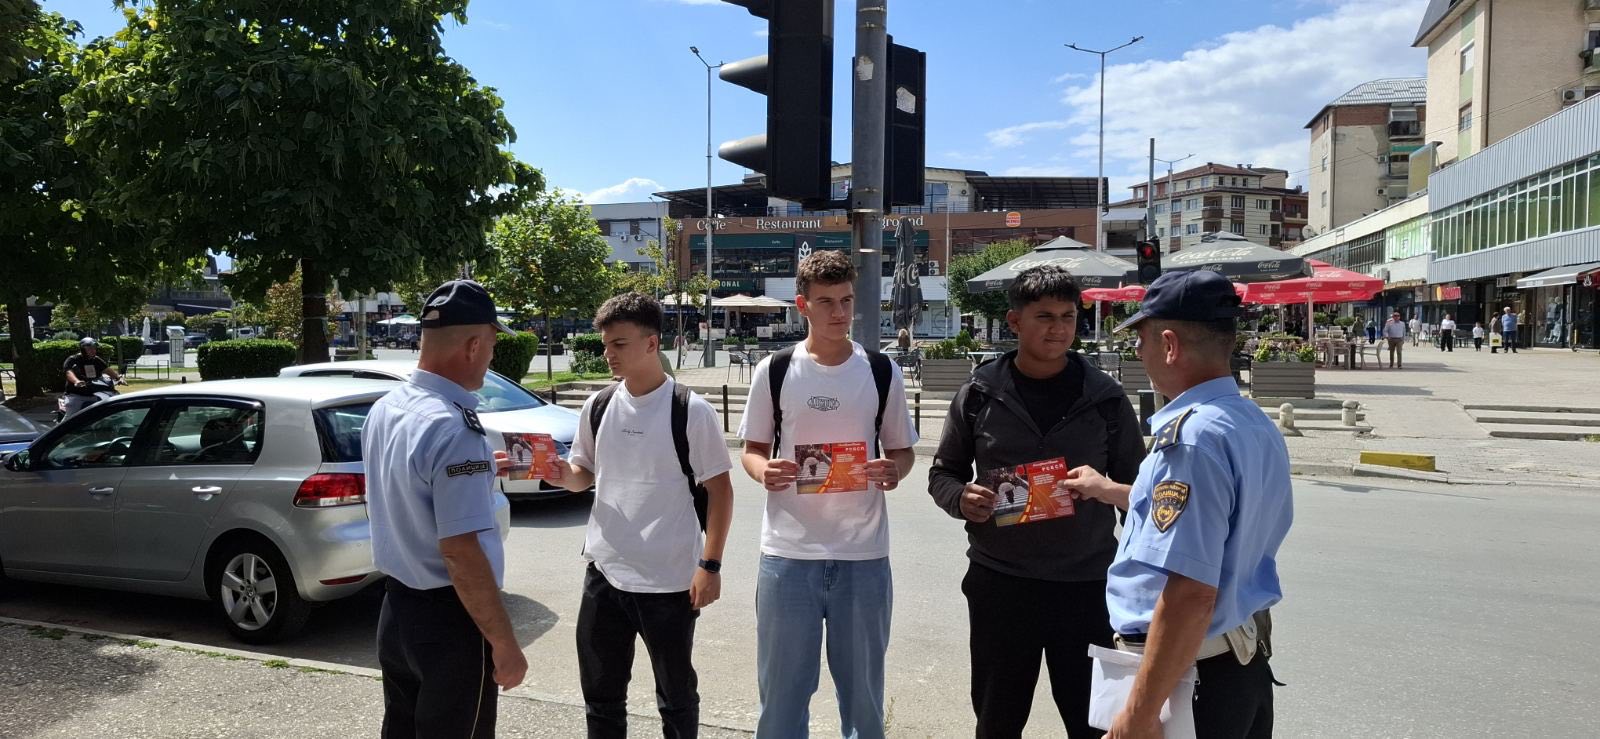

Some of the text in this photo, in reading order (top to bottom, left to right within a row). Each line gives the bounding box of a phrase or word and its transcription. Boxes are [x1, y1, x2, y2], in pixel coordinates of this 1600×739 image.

[756, 218, 822, 229] Restaurant
[1172, 246, 1257, 261] Coca-Cola
[1257, 260, 1281, 270] Coca-Cola
